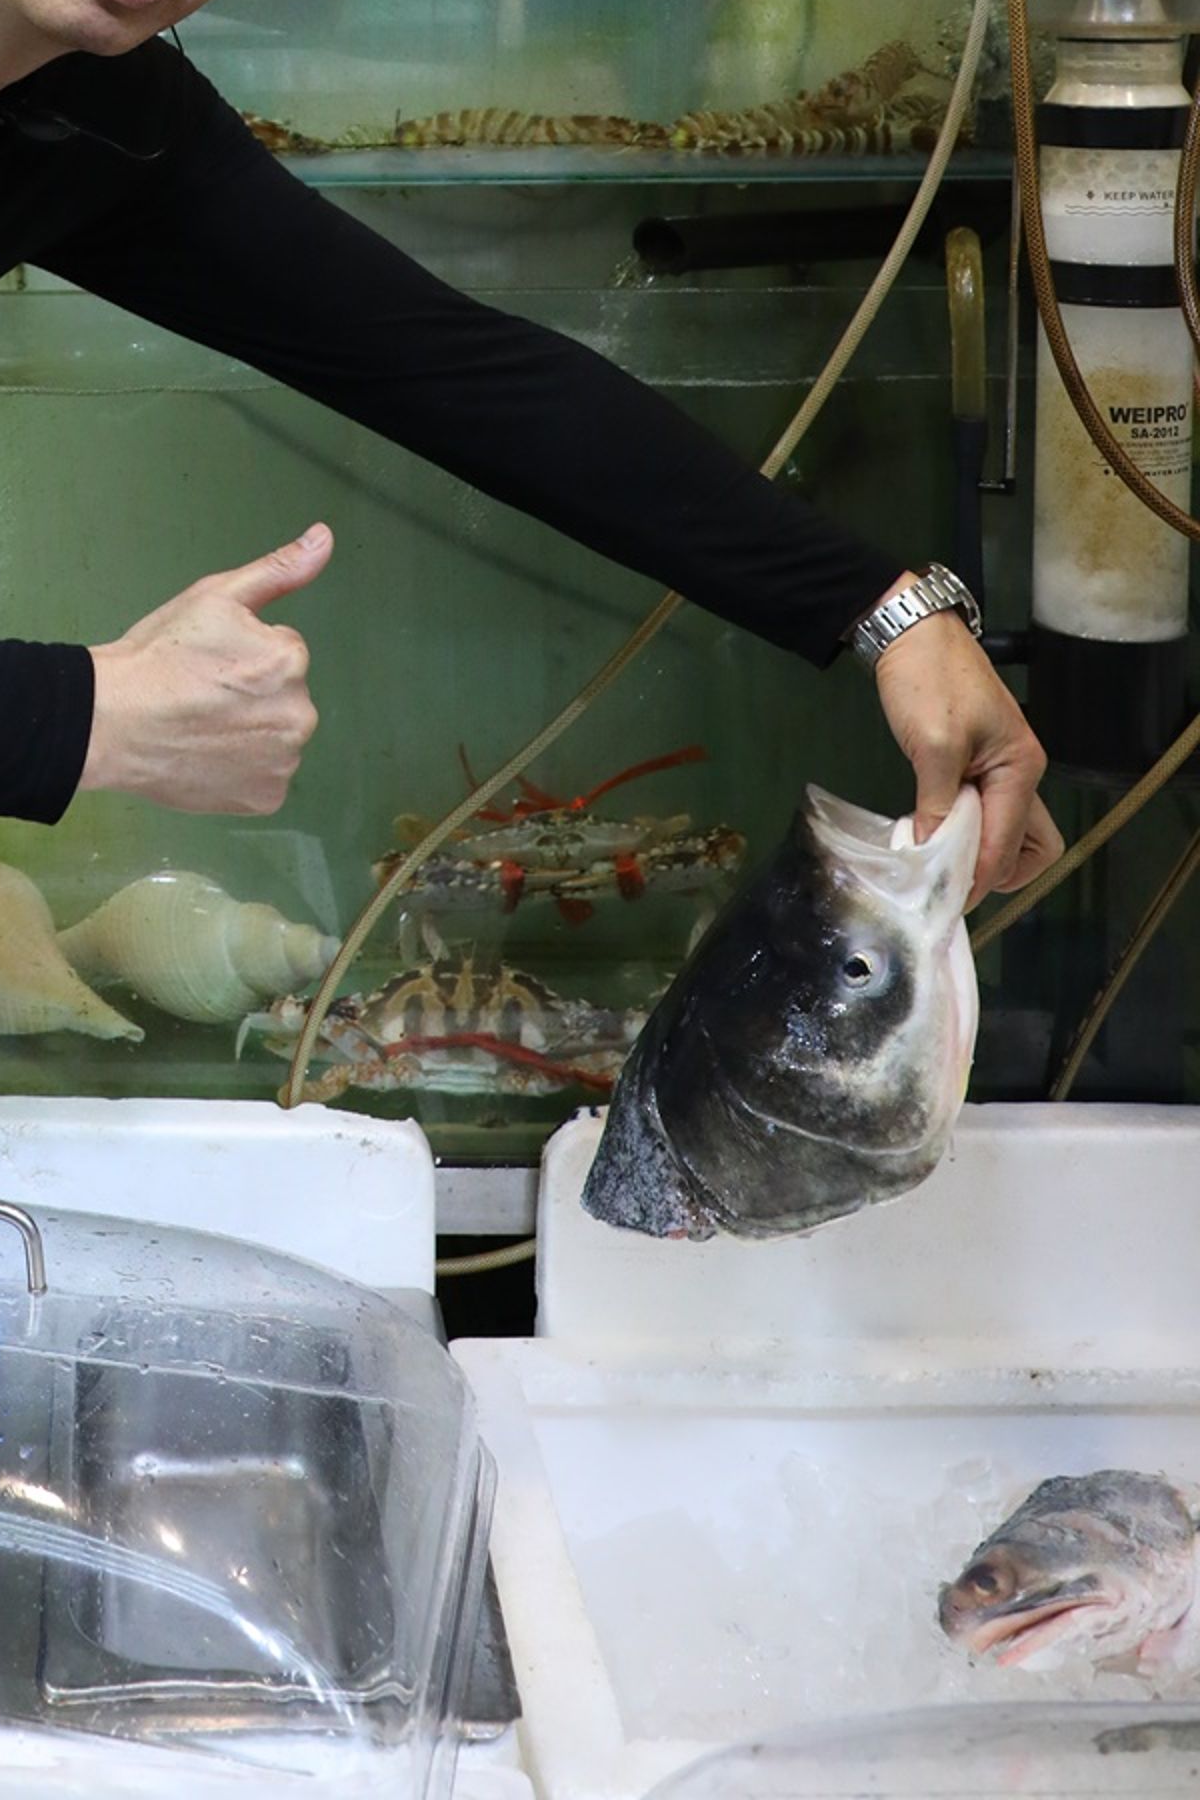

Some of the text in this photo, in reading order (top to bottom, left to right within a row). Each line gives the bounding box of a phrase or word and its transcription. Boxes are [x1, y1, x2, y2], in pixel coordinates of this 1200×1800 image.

[1104, 189, 1174, 201] KEEP WATER
[1109, 404, 1186, 424] WEIPRO
[1131, 426, 1179, 439] SA-2012
